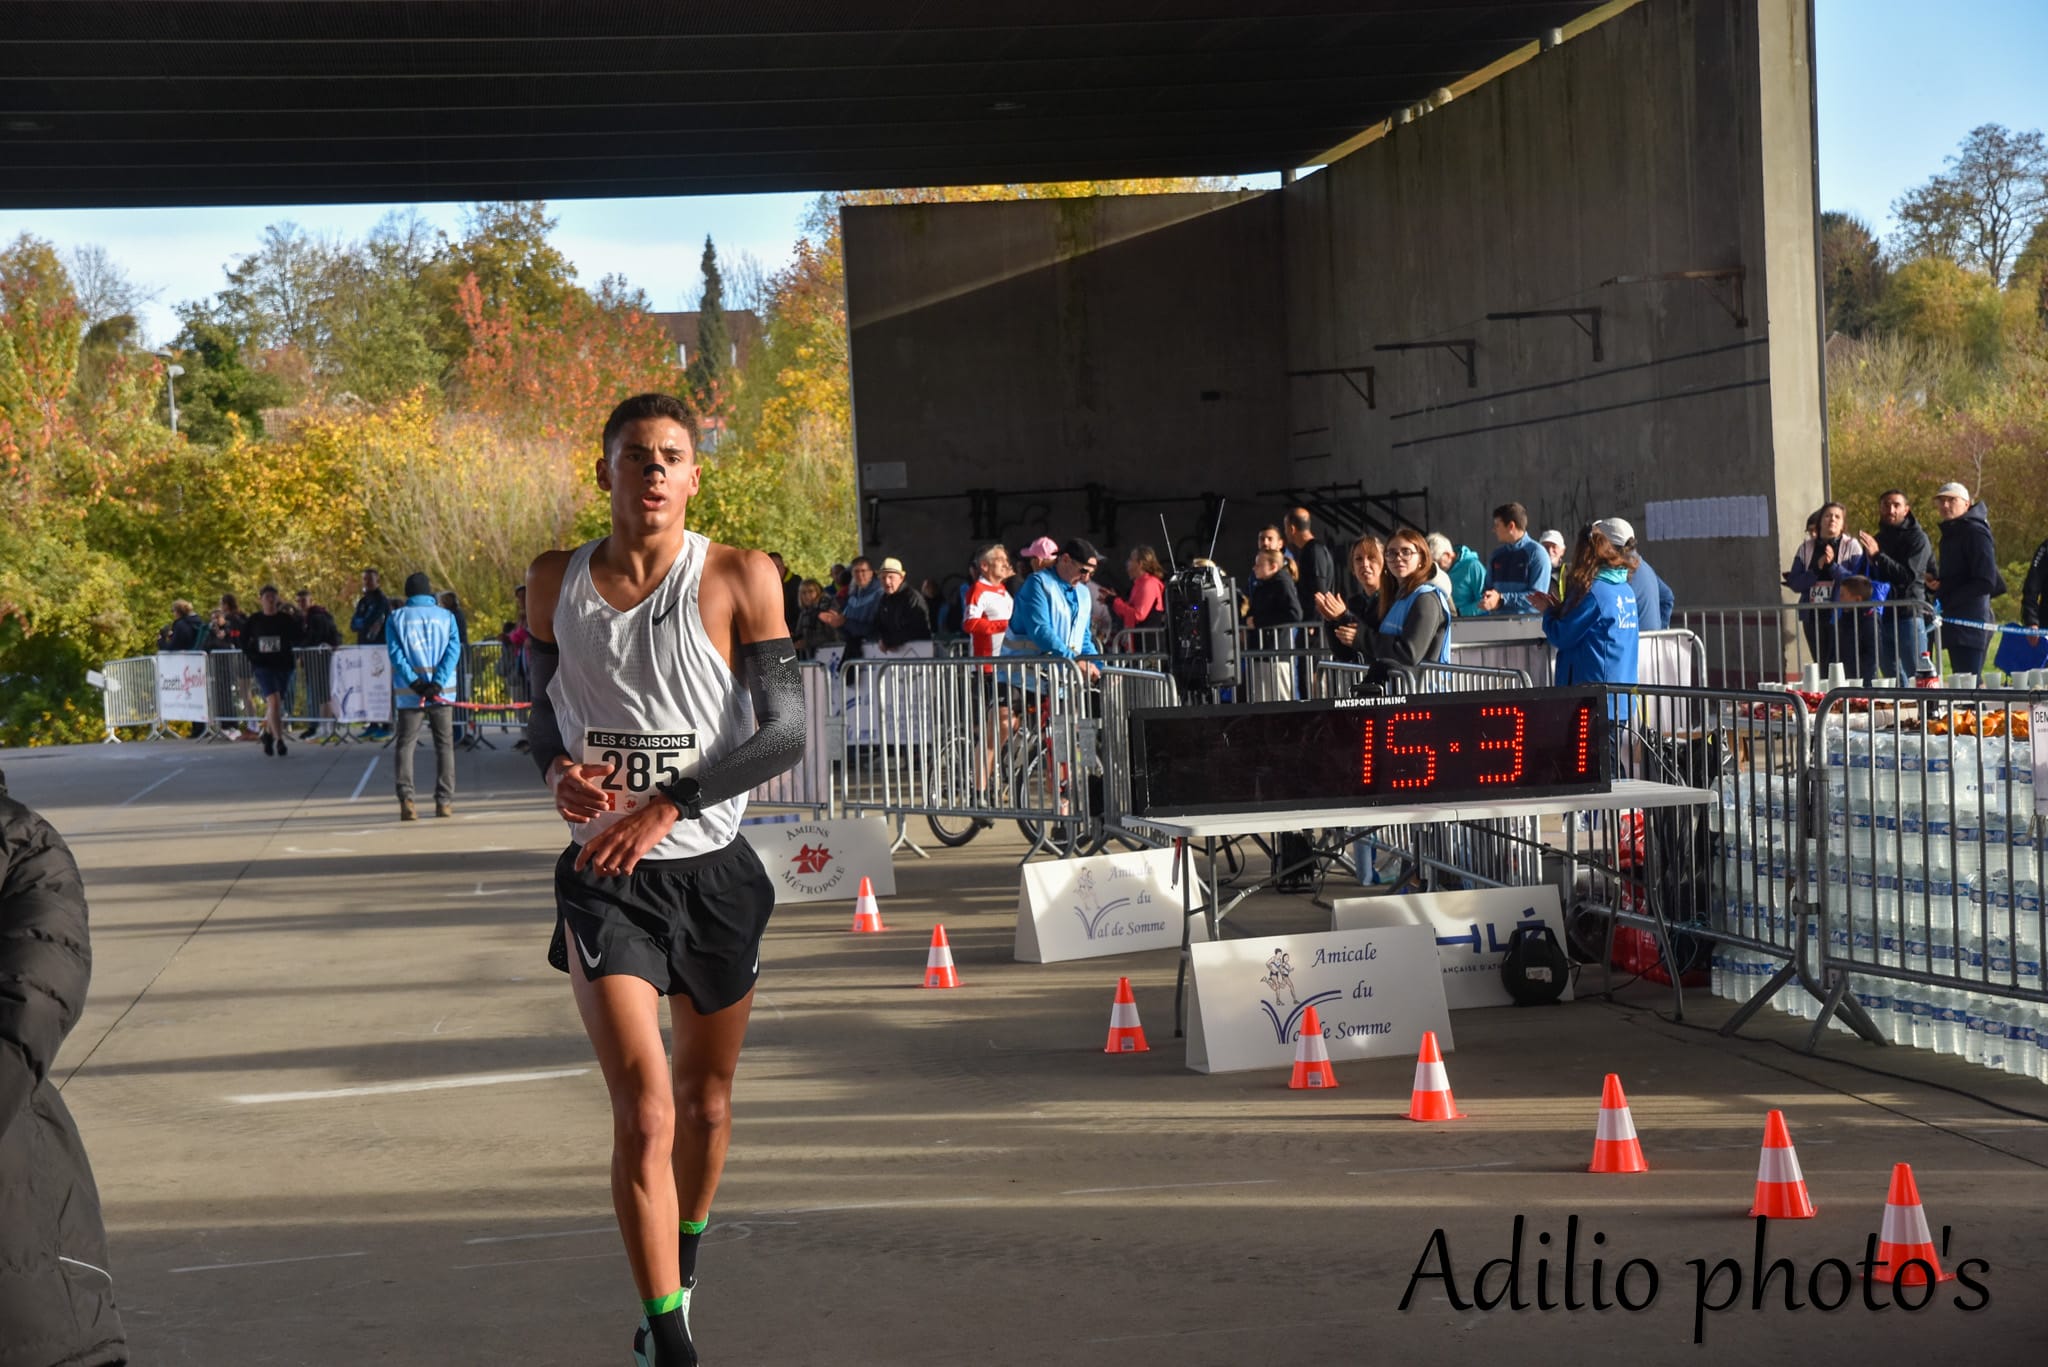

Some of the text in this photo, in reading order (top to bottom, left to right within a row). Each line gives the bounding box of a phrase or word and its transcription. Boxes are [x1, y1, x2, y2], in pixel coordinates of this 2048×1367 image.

[1334, 696, 1407, 708] MATSPORT TIMING
[593, 733, 690, 748] LES 4 SAISONS
[601, 750, 680, 793] 285
[785, 824, 831, 841] AMIENS
[780, 865, 846, 895] MÉTROPOLE
[1136, 889, 1152, 905] du
[1074, 899, 1166, 940] Val de Somme
[1311, 942, 1378, 968] Amicale
[1441, 964, 1477, 977] ANÇAISE
[1352, 979, 1374, 999] du
[1335, 1020, 1392, 1040] Somme
